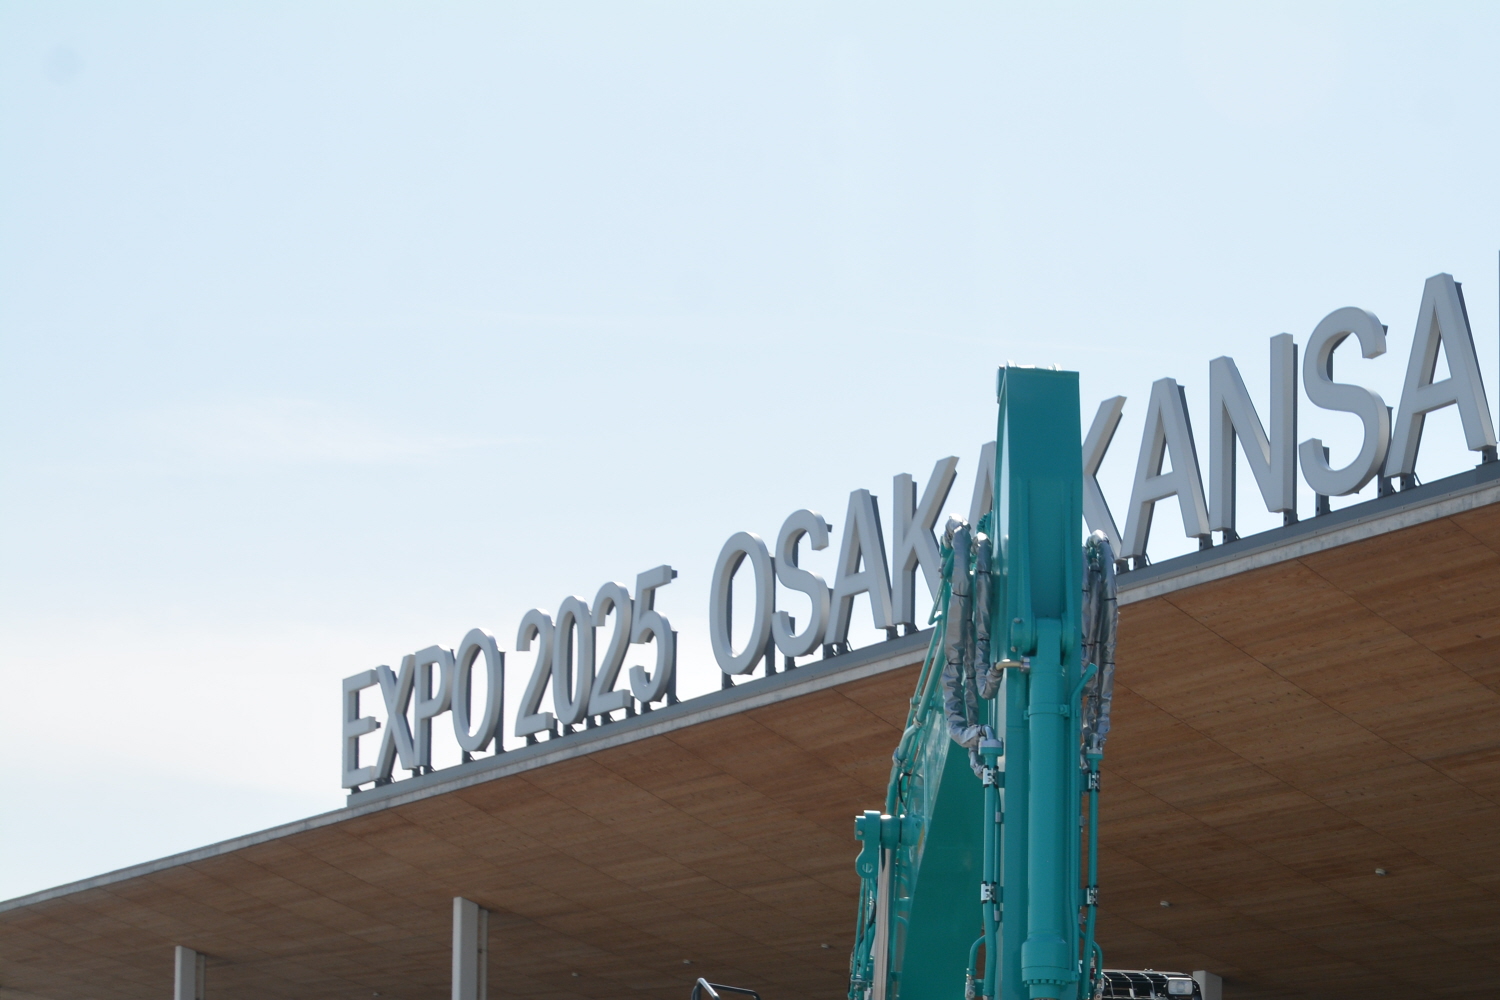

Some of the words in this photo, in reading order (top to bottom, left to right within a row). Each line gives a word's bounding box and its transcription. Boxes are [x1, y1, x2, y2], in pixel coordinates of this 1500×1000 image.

[342, 627, 502, 788] EXPO
[514, 564, 674, 737] 2025
[709, 440, 997, 675] OSAK
